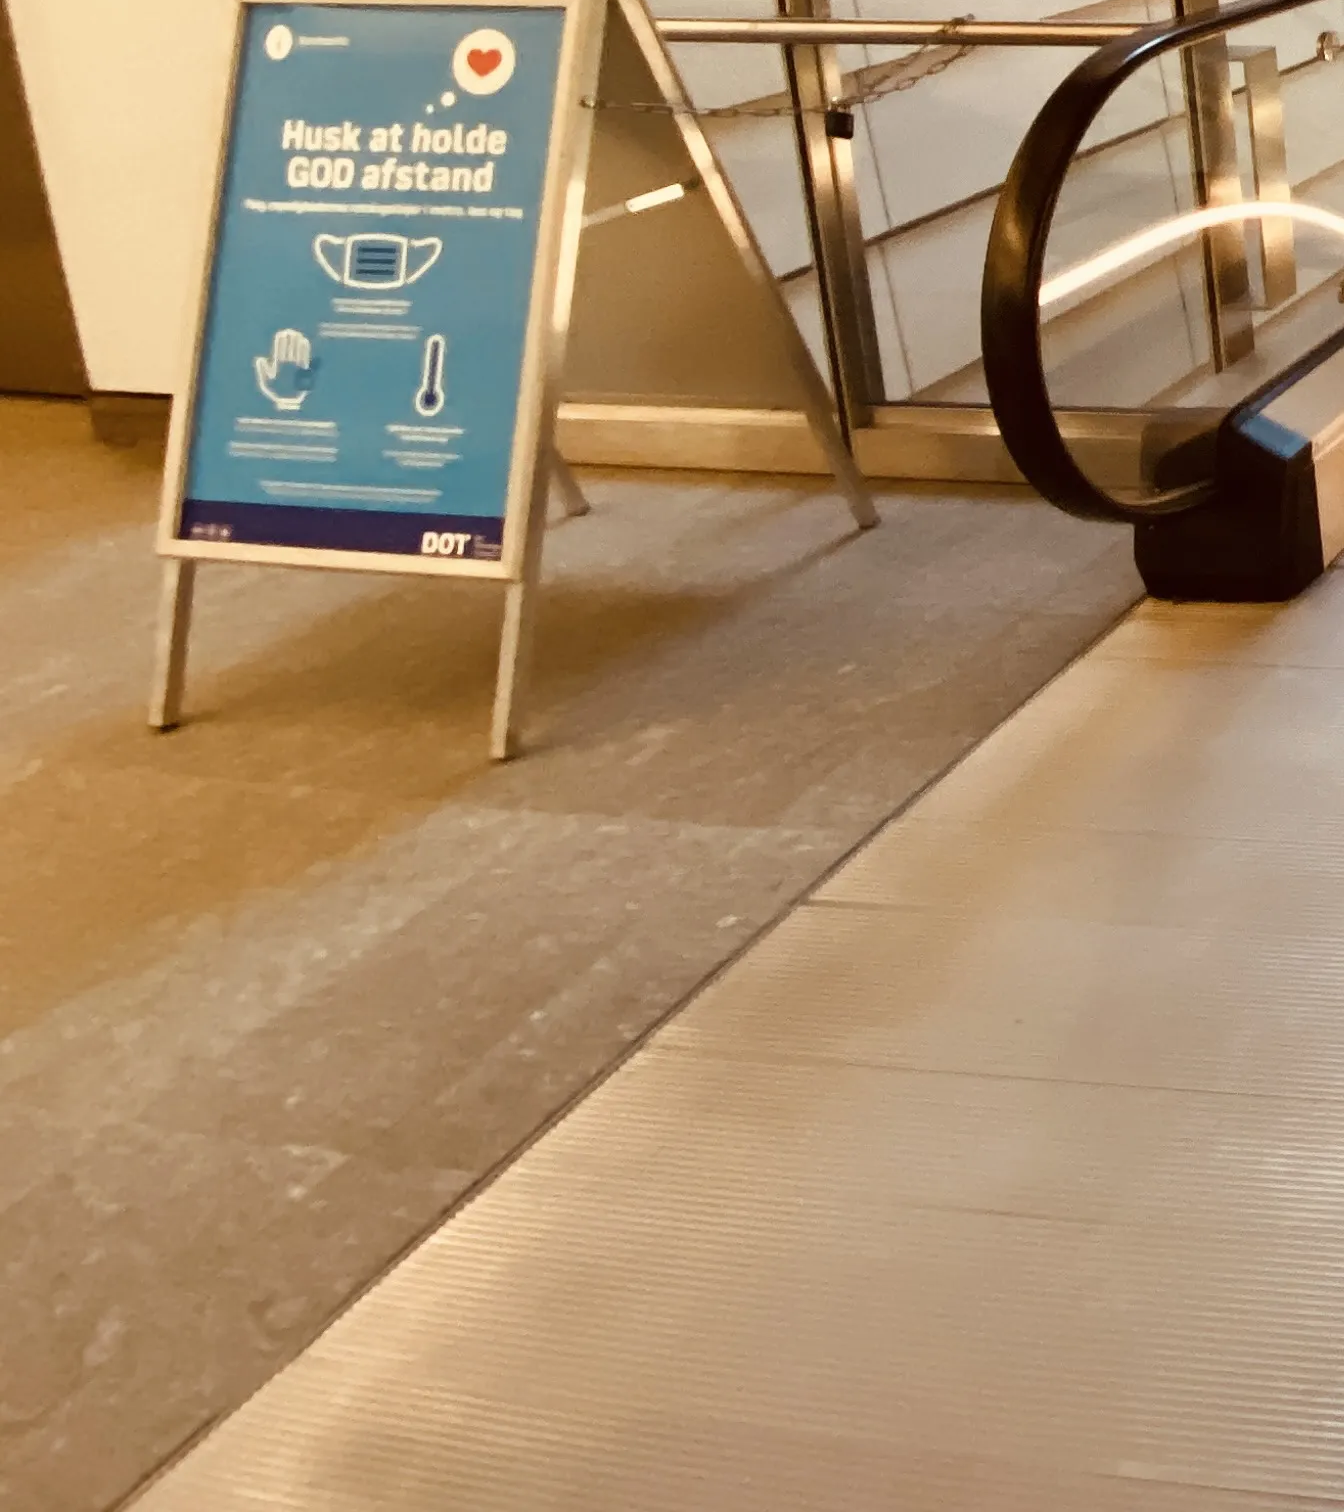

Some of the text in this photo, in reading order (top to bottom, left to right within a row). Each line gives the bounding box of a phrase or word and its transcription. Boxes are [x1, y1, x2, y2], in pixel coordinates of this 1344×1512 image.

[282, 119, 508, 156] Husk at holde
[287, 155, 494, 192] GOD afstand
[421, 531, 472, 556] DOT
